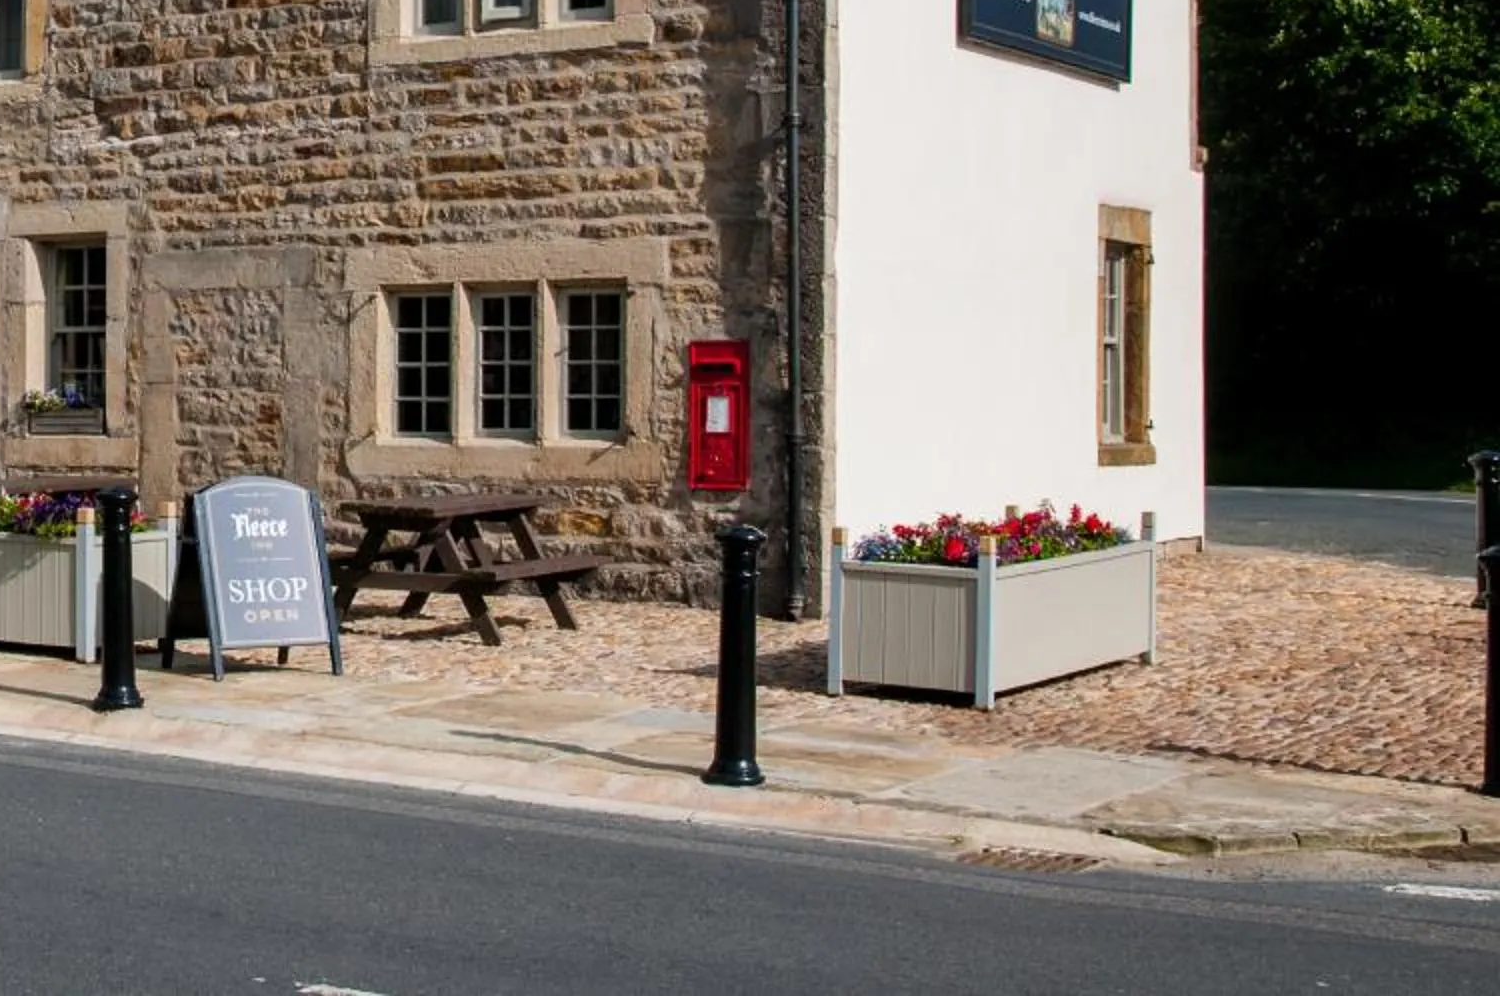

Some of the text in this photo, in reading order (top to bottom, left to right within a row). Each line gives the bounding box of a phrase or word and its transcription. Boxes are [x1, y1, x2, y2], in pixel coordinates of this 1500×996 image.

[230, 513, 289, 541] Fleece
[228, 577, 308, 604] SHOP
[243, 608, 299, 623] OPEN
